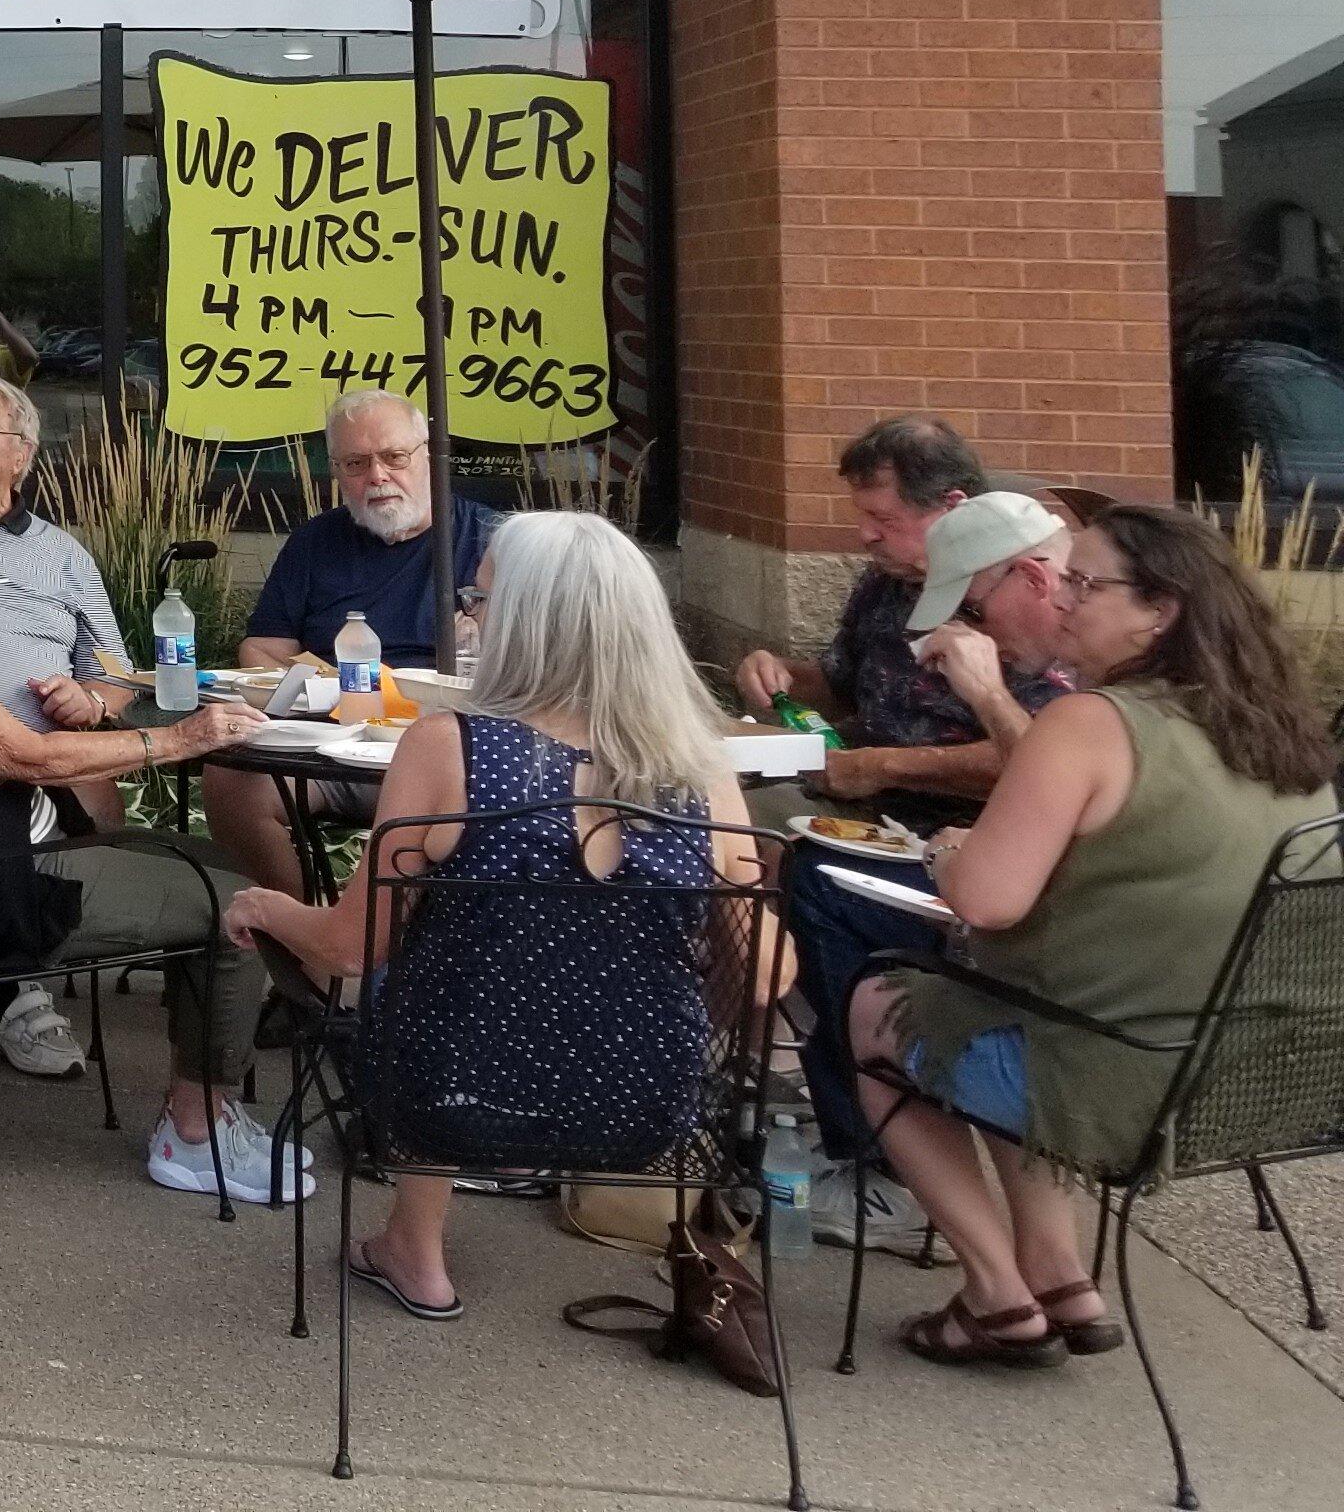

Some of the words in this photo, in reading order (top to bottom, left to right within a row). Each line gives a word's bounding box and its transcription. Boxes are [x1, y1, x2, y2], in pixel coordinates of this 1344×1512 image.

[176, 116, 256, 197] We
[274, 95, 596, 212] DELVER
[201, 283, 240, 331] 4
